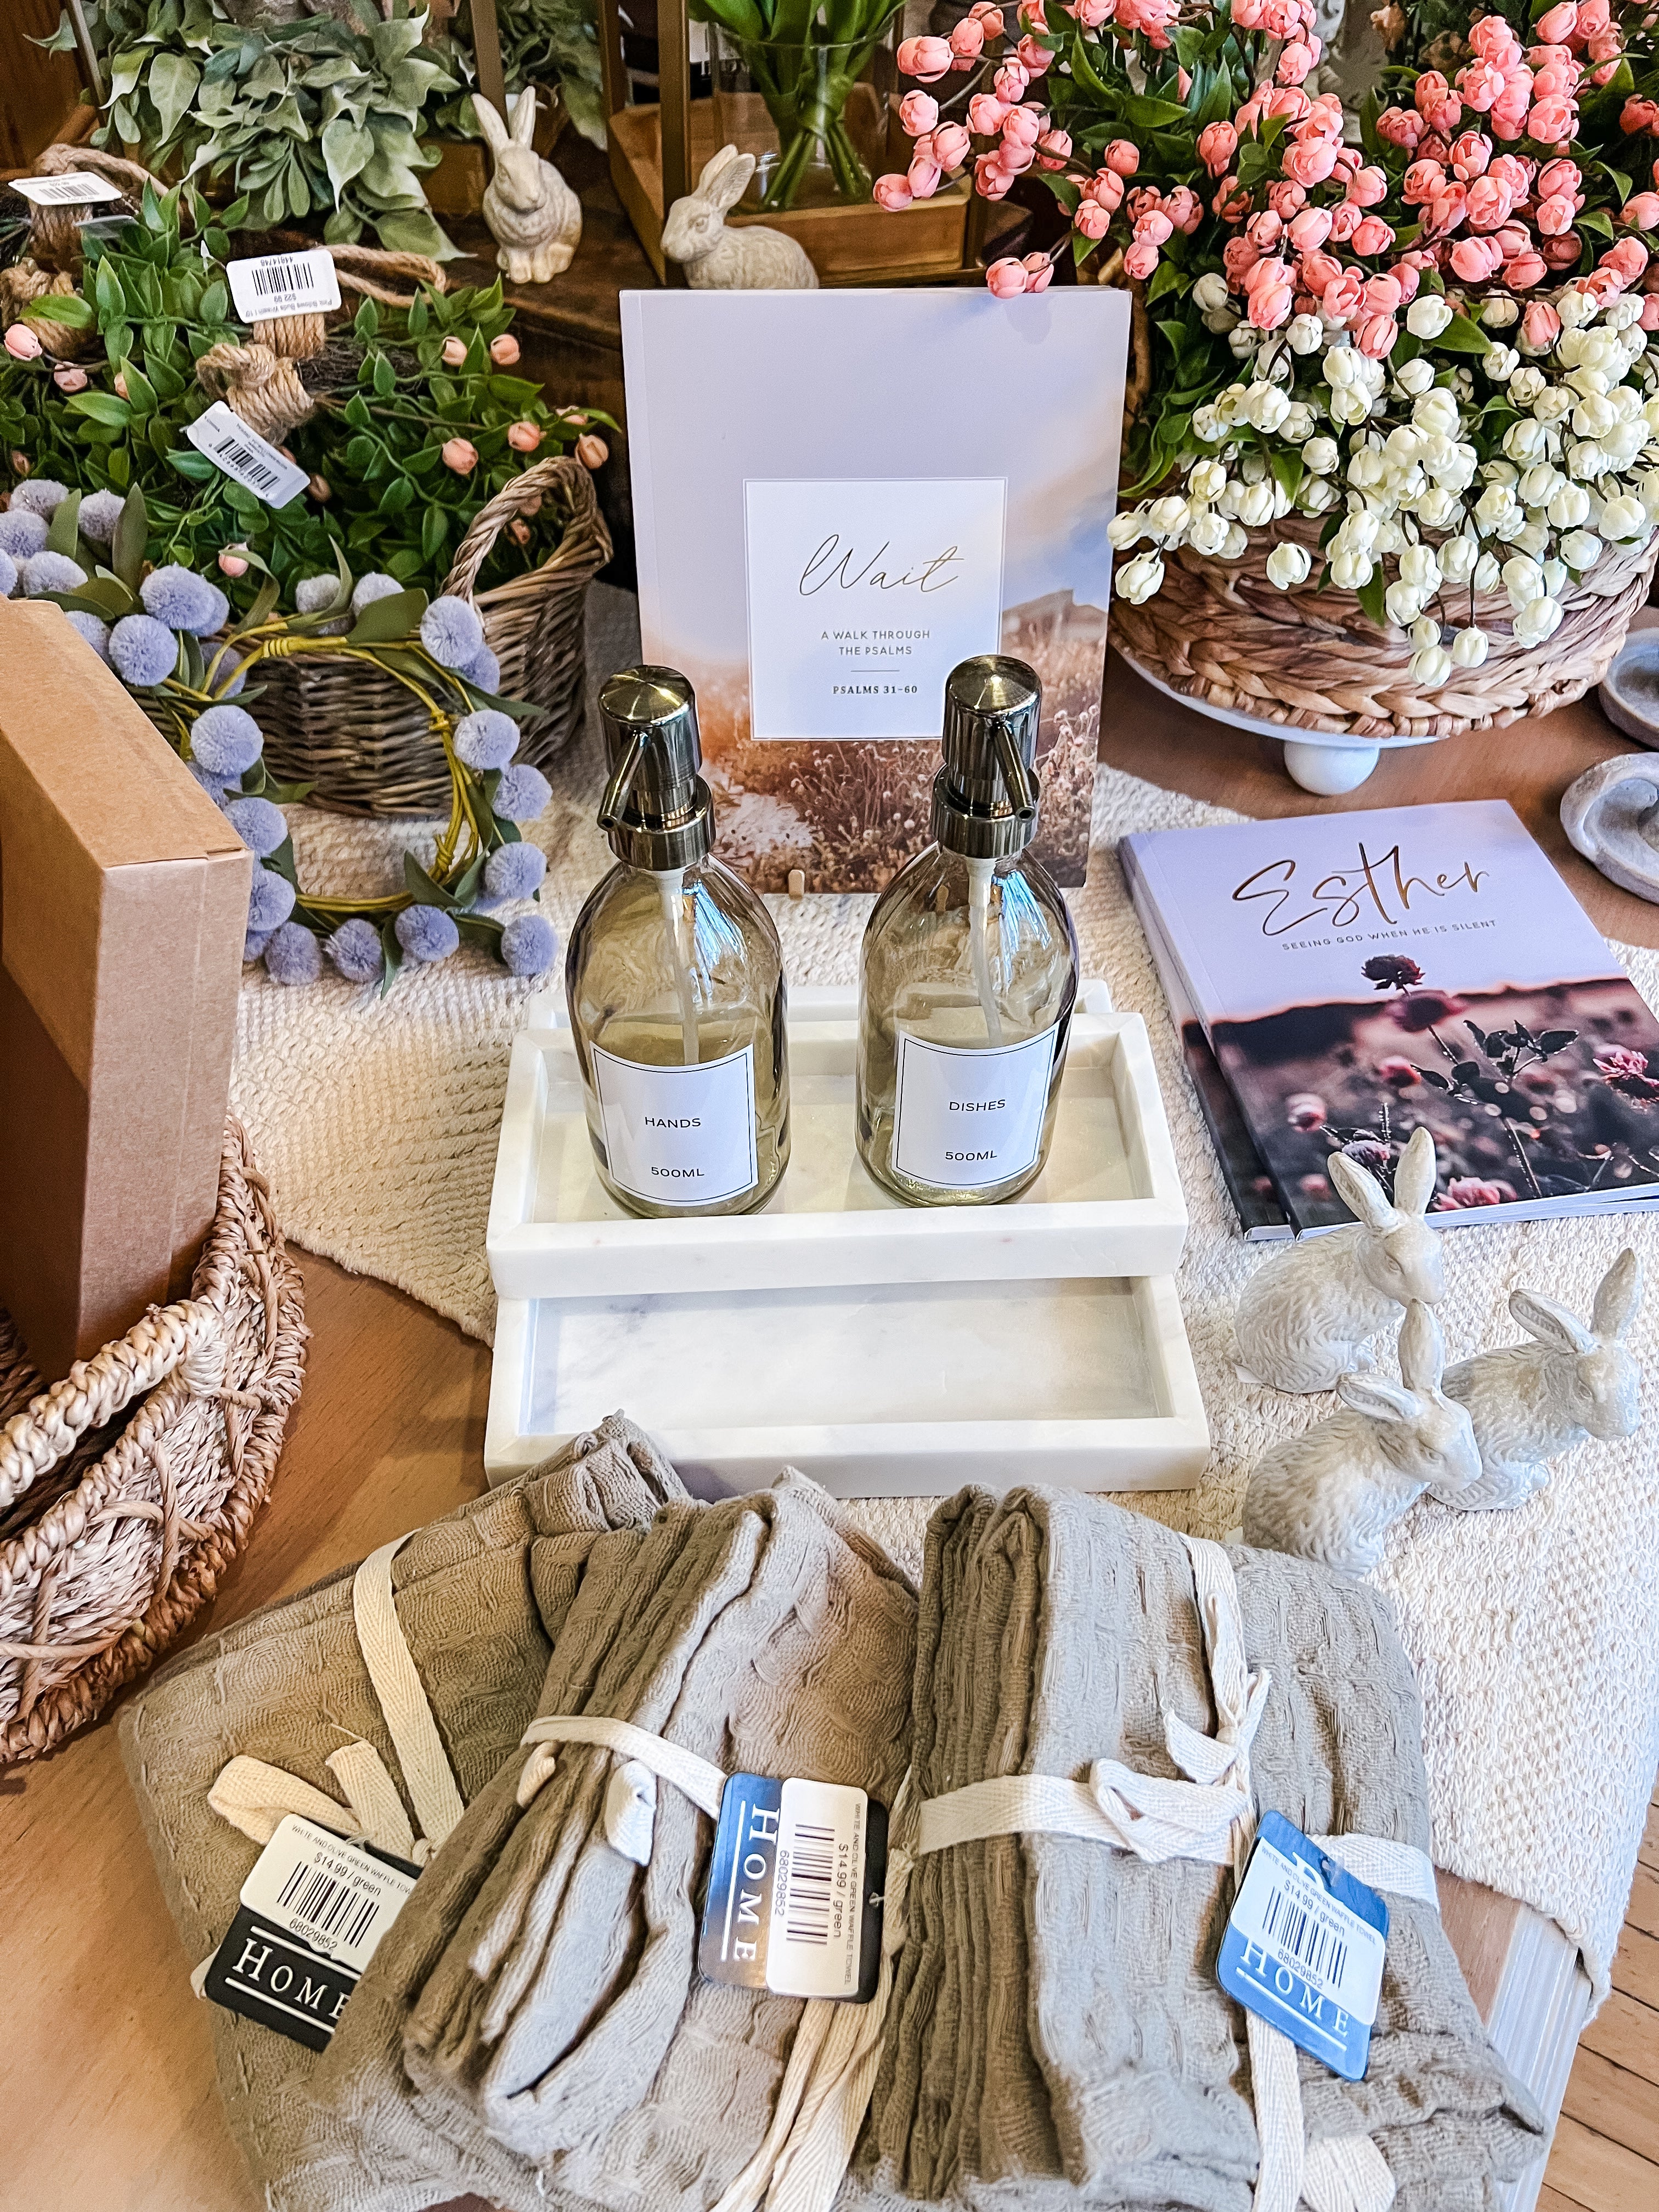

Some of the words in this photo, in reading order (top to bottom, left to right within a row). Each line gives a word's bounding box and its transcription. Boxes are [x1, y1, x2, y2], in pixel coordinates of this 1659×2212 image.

[799, 534, 964, 596] Wait
[821, 630, 830, 640] A
[833, 630, 868, 640] WALK
[872, 629, 931, 640] THROUGH
[839, 646, 863, 656] THE
[865, 646, 913, 656] PSALMS
[833, 685, 879, 695] PSALMS
[1232, 842, 1490, 938] Esther
[1282, 938, 1331, 951] SEEING
[1336, 934, 1363, 944] GOD
[1367, 929, 1408, 940] WHEN
[1412, 926, 1430, 936] HE
[1434, 924, 1447, 934] IS
[1451, 919, 1497, 932] SILENT
[645, 1116, 702, 1129] HANDS
[949, 1098, 1006, 1112] DISHES
[651, 1166, 706, 1178] 500ML
[944, 1150, 998, 1161] 500ML
[291, 1824, 313, 1841] WHITE
[313, 1836, 328, 1851] AND
[328, 1844, 346, 1859] OLIVE
[347, 1854, 371, 1872] GREEN
[370, 1867, 396, 1887] WAFFLE
[836, 1842, 849, 1888] $14.99
[850, 1853, 859, 1879] OLIVE
[314, 1852, 348, 1877] $14.99
[353, 1875, 382, 1897] green
[733, 1803, 781, 1961] HOME
[774, 1849, 790, 1917] 68029852
[1262, 1845, 1279, 1866] WHITE
[1281, 1861, 1292, 1877] AND
[1293, 1872, 1310, 1891] OLIVE
[1310, 1885, 1331, 1909] GREEN
[1331, 1904, 1355, 1929] WAFFLE
[1356, 1922, 1376, 1945] TOWEL
[1284, 1879, 1314, 1910] $14.99
[1319, 1911, 1345, 1937] green
[289, 1918, 338, 1950] 68029852
[833, 1899, 844, 1938] green
[846, 1915, 854, 1950] WAFFLE
[844, 1954, 853, 1985] TOWEL
[1240, 1937, 1350, 2038] HOME
[1278, 1948, 1324, 1990] 68029852
